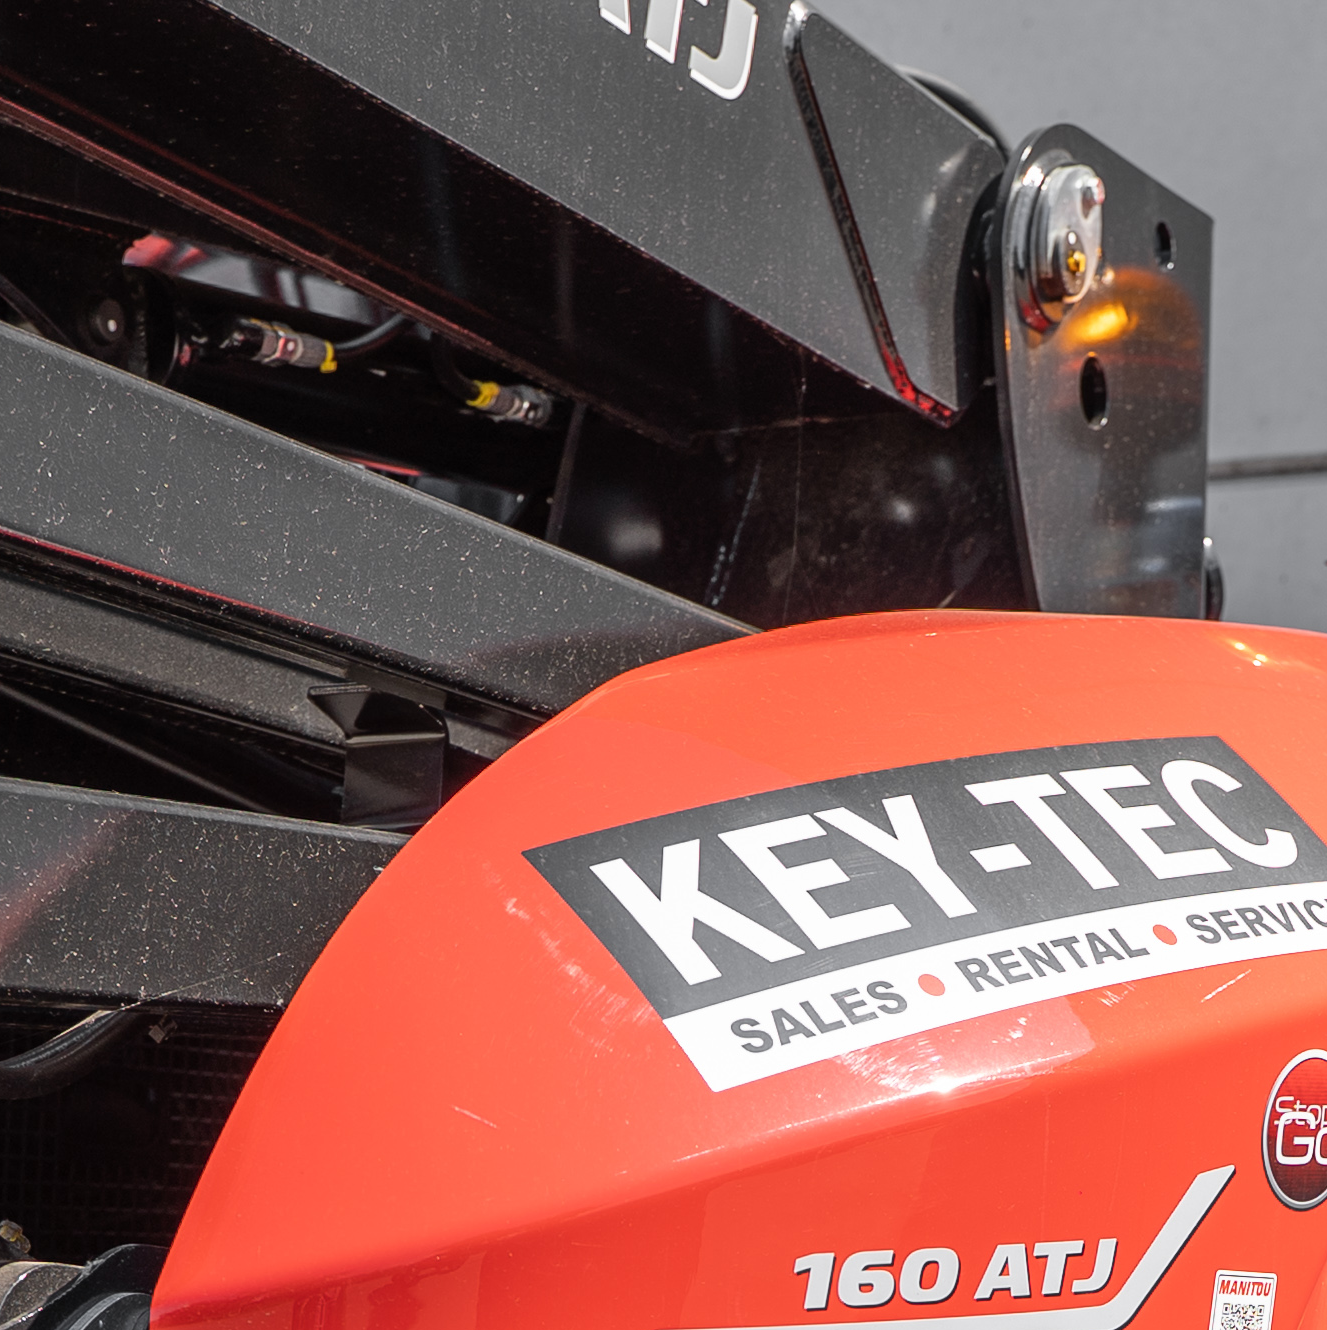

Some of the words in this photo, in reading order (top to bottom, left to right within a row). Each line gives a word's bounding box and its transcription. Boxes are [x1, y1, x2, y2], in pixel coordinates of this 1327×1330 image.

[590, 760, 1298, 985] KEY-TEC
[730, 981, 908, 1054] SALES
[955, 926, 1149, 993] RENTAL
[793, 1247, 961, 1310] 160
[973, 1238, 1118, 1300] ATJ
[1219, 1280, 1271, 1296] MANITOU
